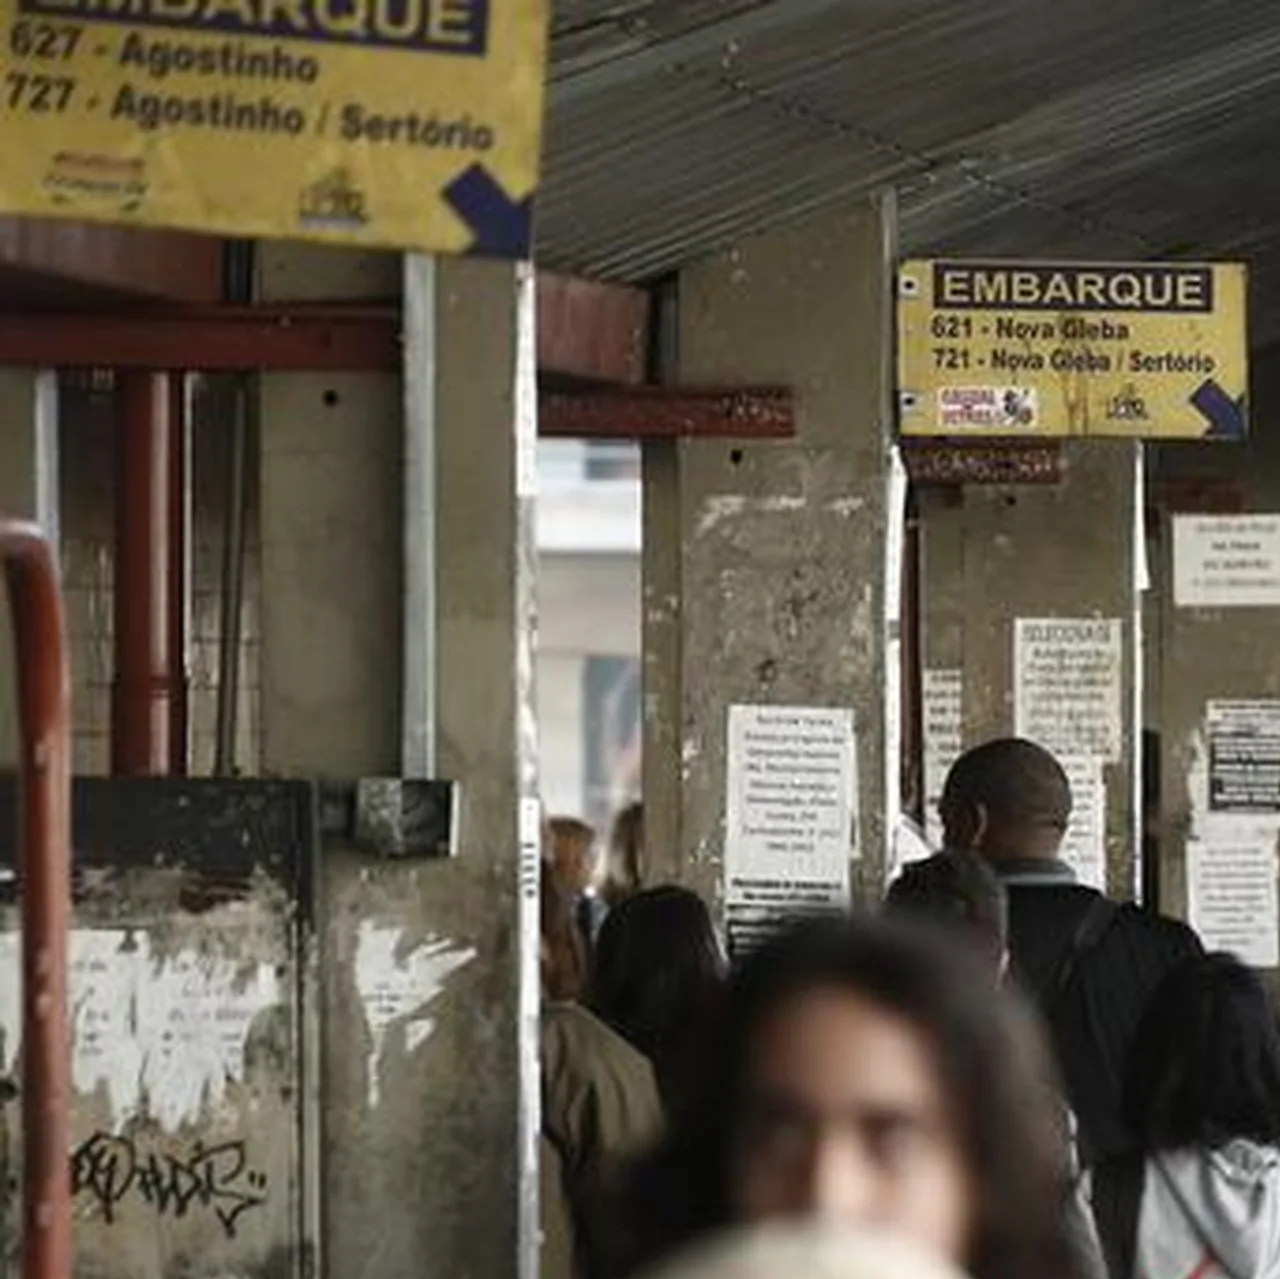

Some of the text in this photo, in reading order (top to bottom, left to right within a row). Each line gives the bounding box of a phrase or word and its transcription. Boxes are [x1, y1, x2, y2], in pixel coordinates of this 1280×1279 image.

[38, 0, 472, 43] RQUE
[12, 20, 84, 59] 627
[119, 31, 319, 83] Agostinho
[5, 70, 76, 113] 727
[109, 83, 305, 132] Agostinho
[340, 103, 494, 150] Sertório
[943, 271, 1202, 306] EMBARQUE
[931, 316, 972, 338] 621
[996, 318, 1055, 339] Nova
[1060, 318, 1129, 340] Gleba
[931, 349, 971, 370] 721
[990, 350, 1044, 371] Nova
[1050, 350, 1110, 371] Gleba
